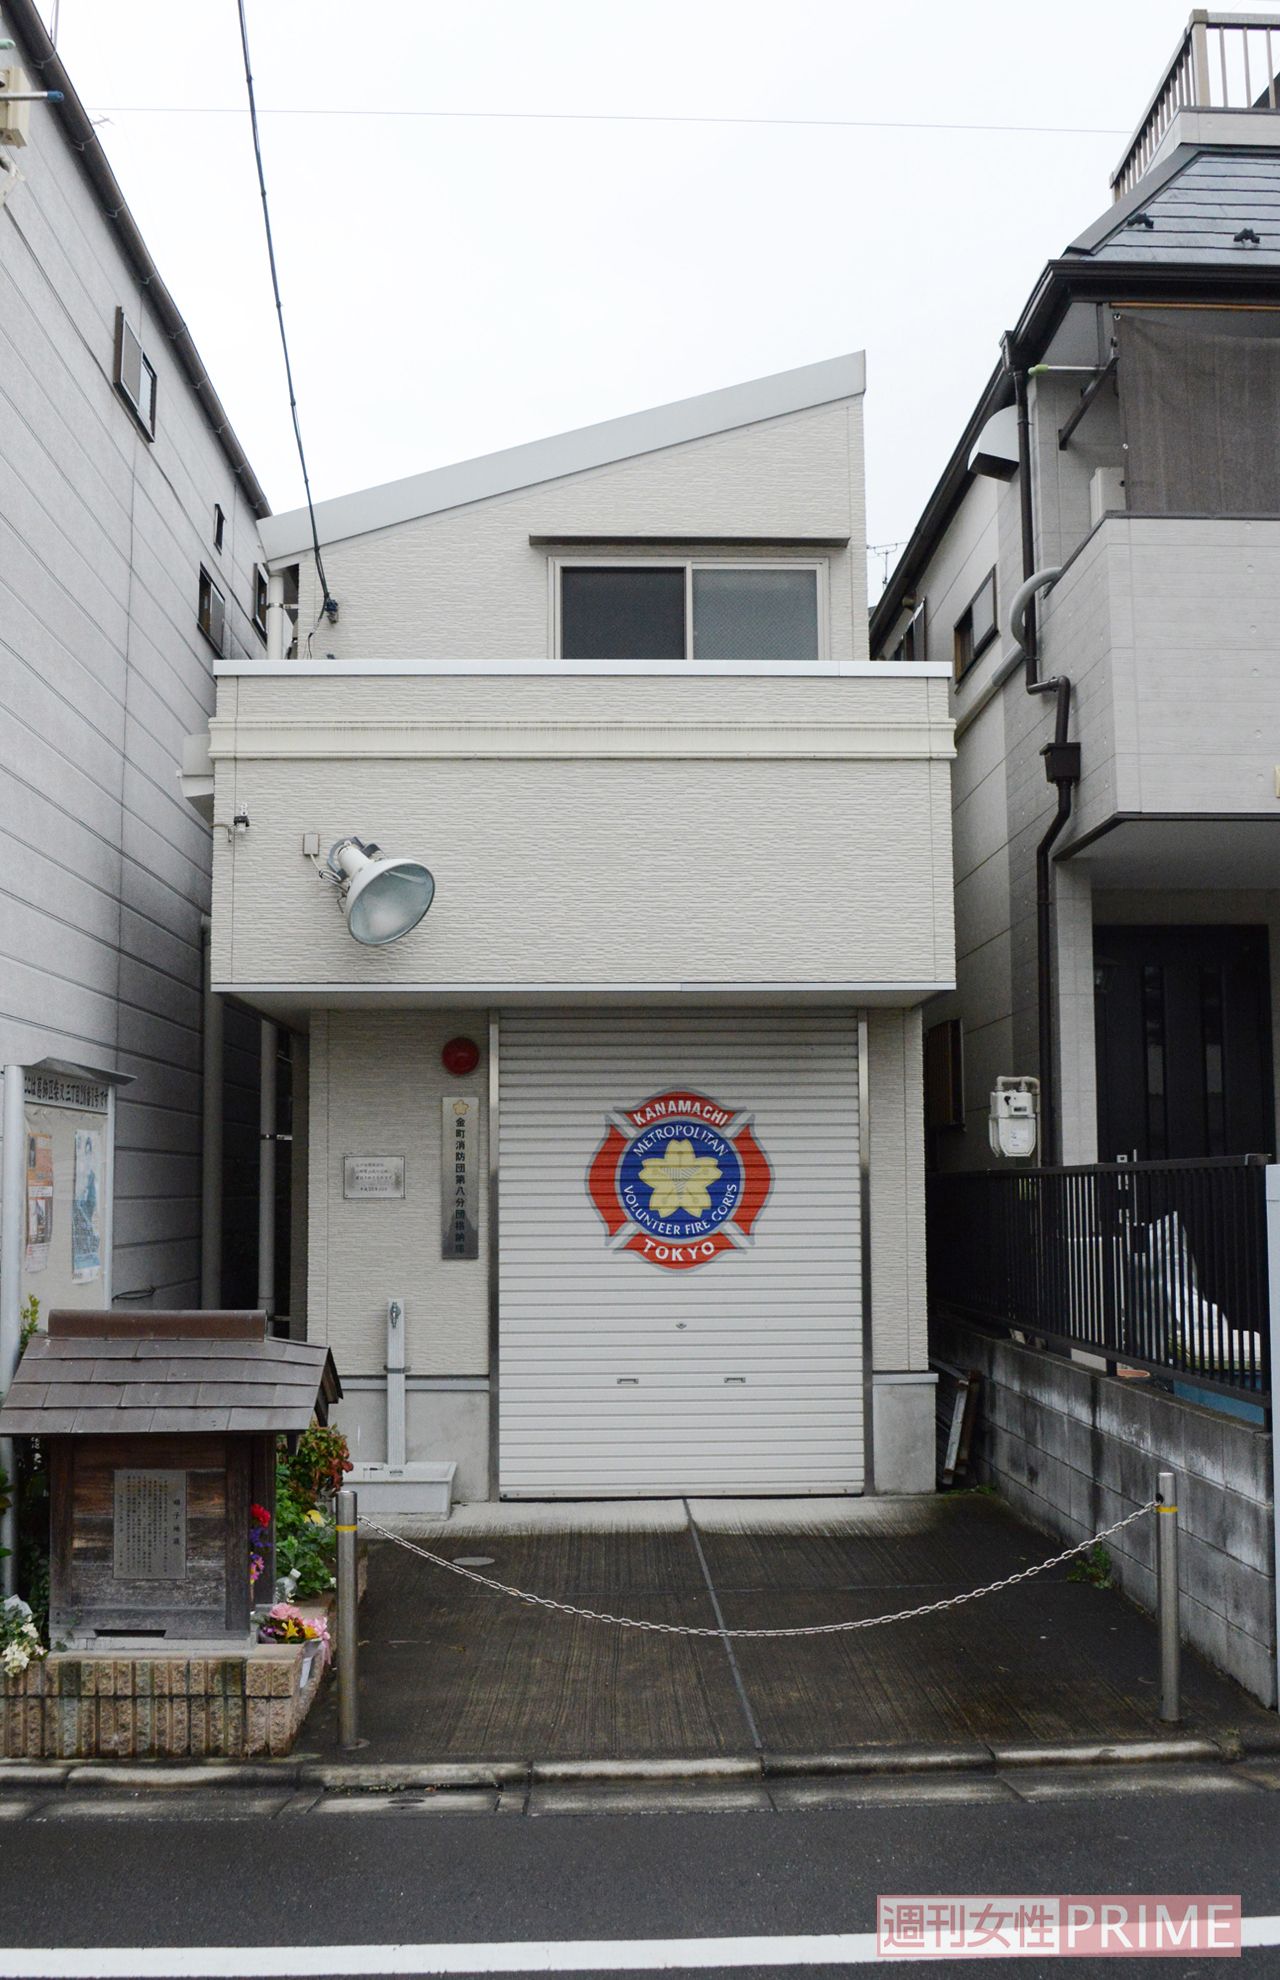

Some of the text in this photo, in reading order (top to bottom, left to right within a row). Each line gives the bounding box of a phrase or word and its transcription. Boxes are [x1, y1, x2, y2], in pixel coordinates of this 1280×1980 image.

[633, 1100, 728, 1125] KANAMACHI
[633, 1125, 729, 1157] METROPOLITAN
[624, 1184, 737, 1235] VOLUNTEER FIRE CORPS
[644, 1239, 715, 1261] TOKYO
